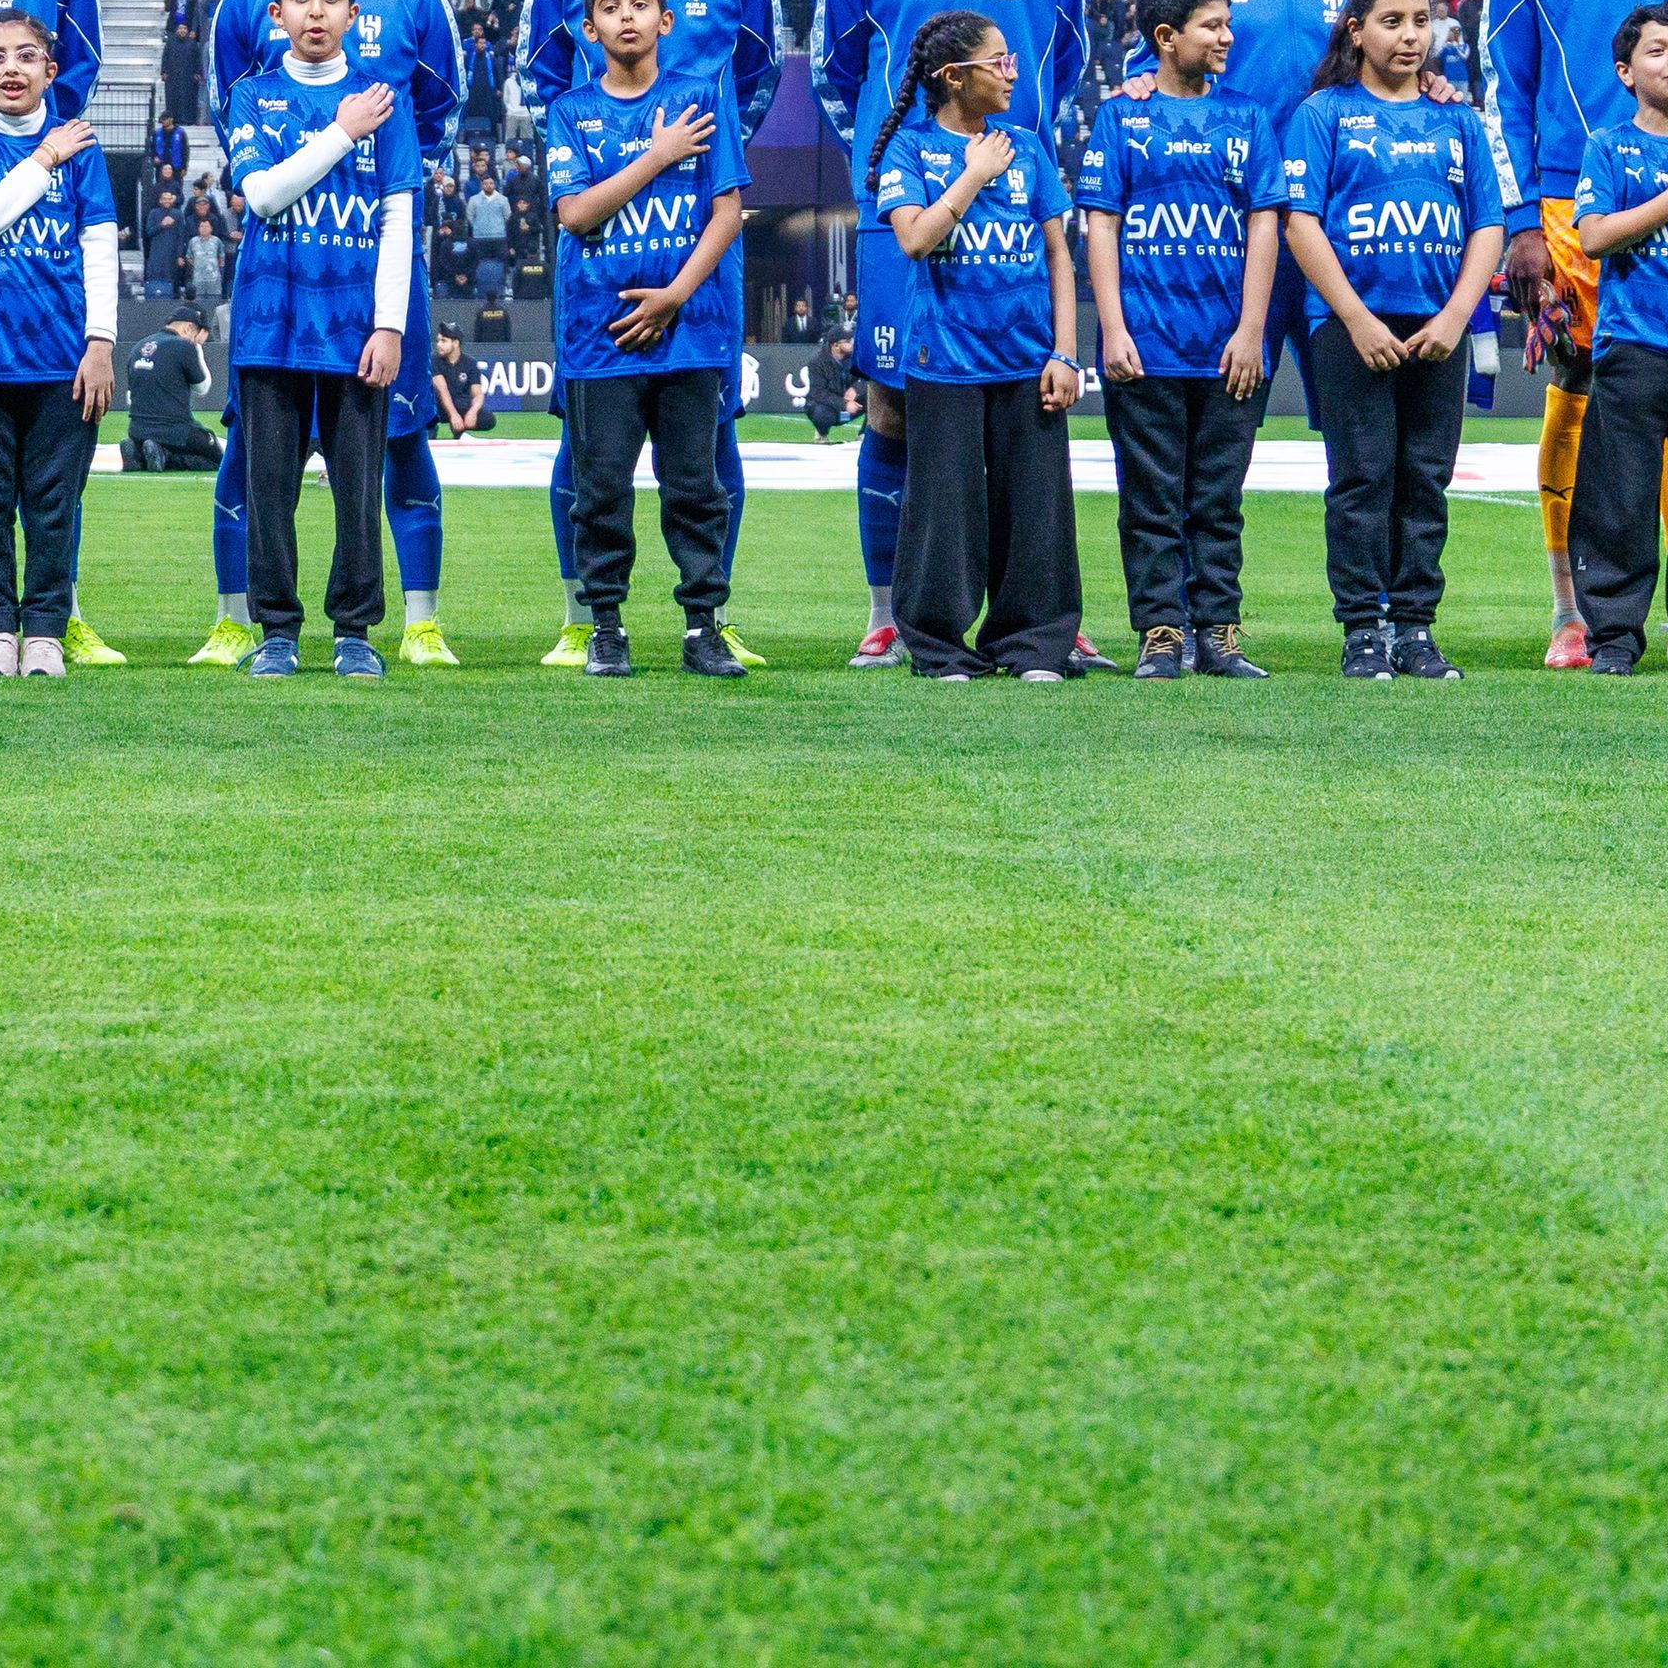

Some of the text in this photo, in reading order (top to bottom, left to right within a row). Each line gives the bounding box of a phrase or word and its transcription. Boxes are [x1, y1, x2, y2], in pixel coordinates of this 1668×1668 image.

[618, 137, 653, 157] jahe
[1125, 202, 1245, 242] SAVVY
[1347, 200, 1462, 241] SAVVY
[319, 232, 375, 250] GROUP
[582, 235, 643, 259] GAMES
[1125, 244, 1187, 256] GAMES
[1350, 241, 1463, 256] GAMES GROUP
[988, 252, 1035, 264] GROUP
[476, 360, 557, 397] SAUD
